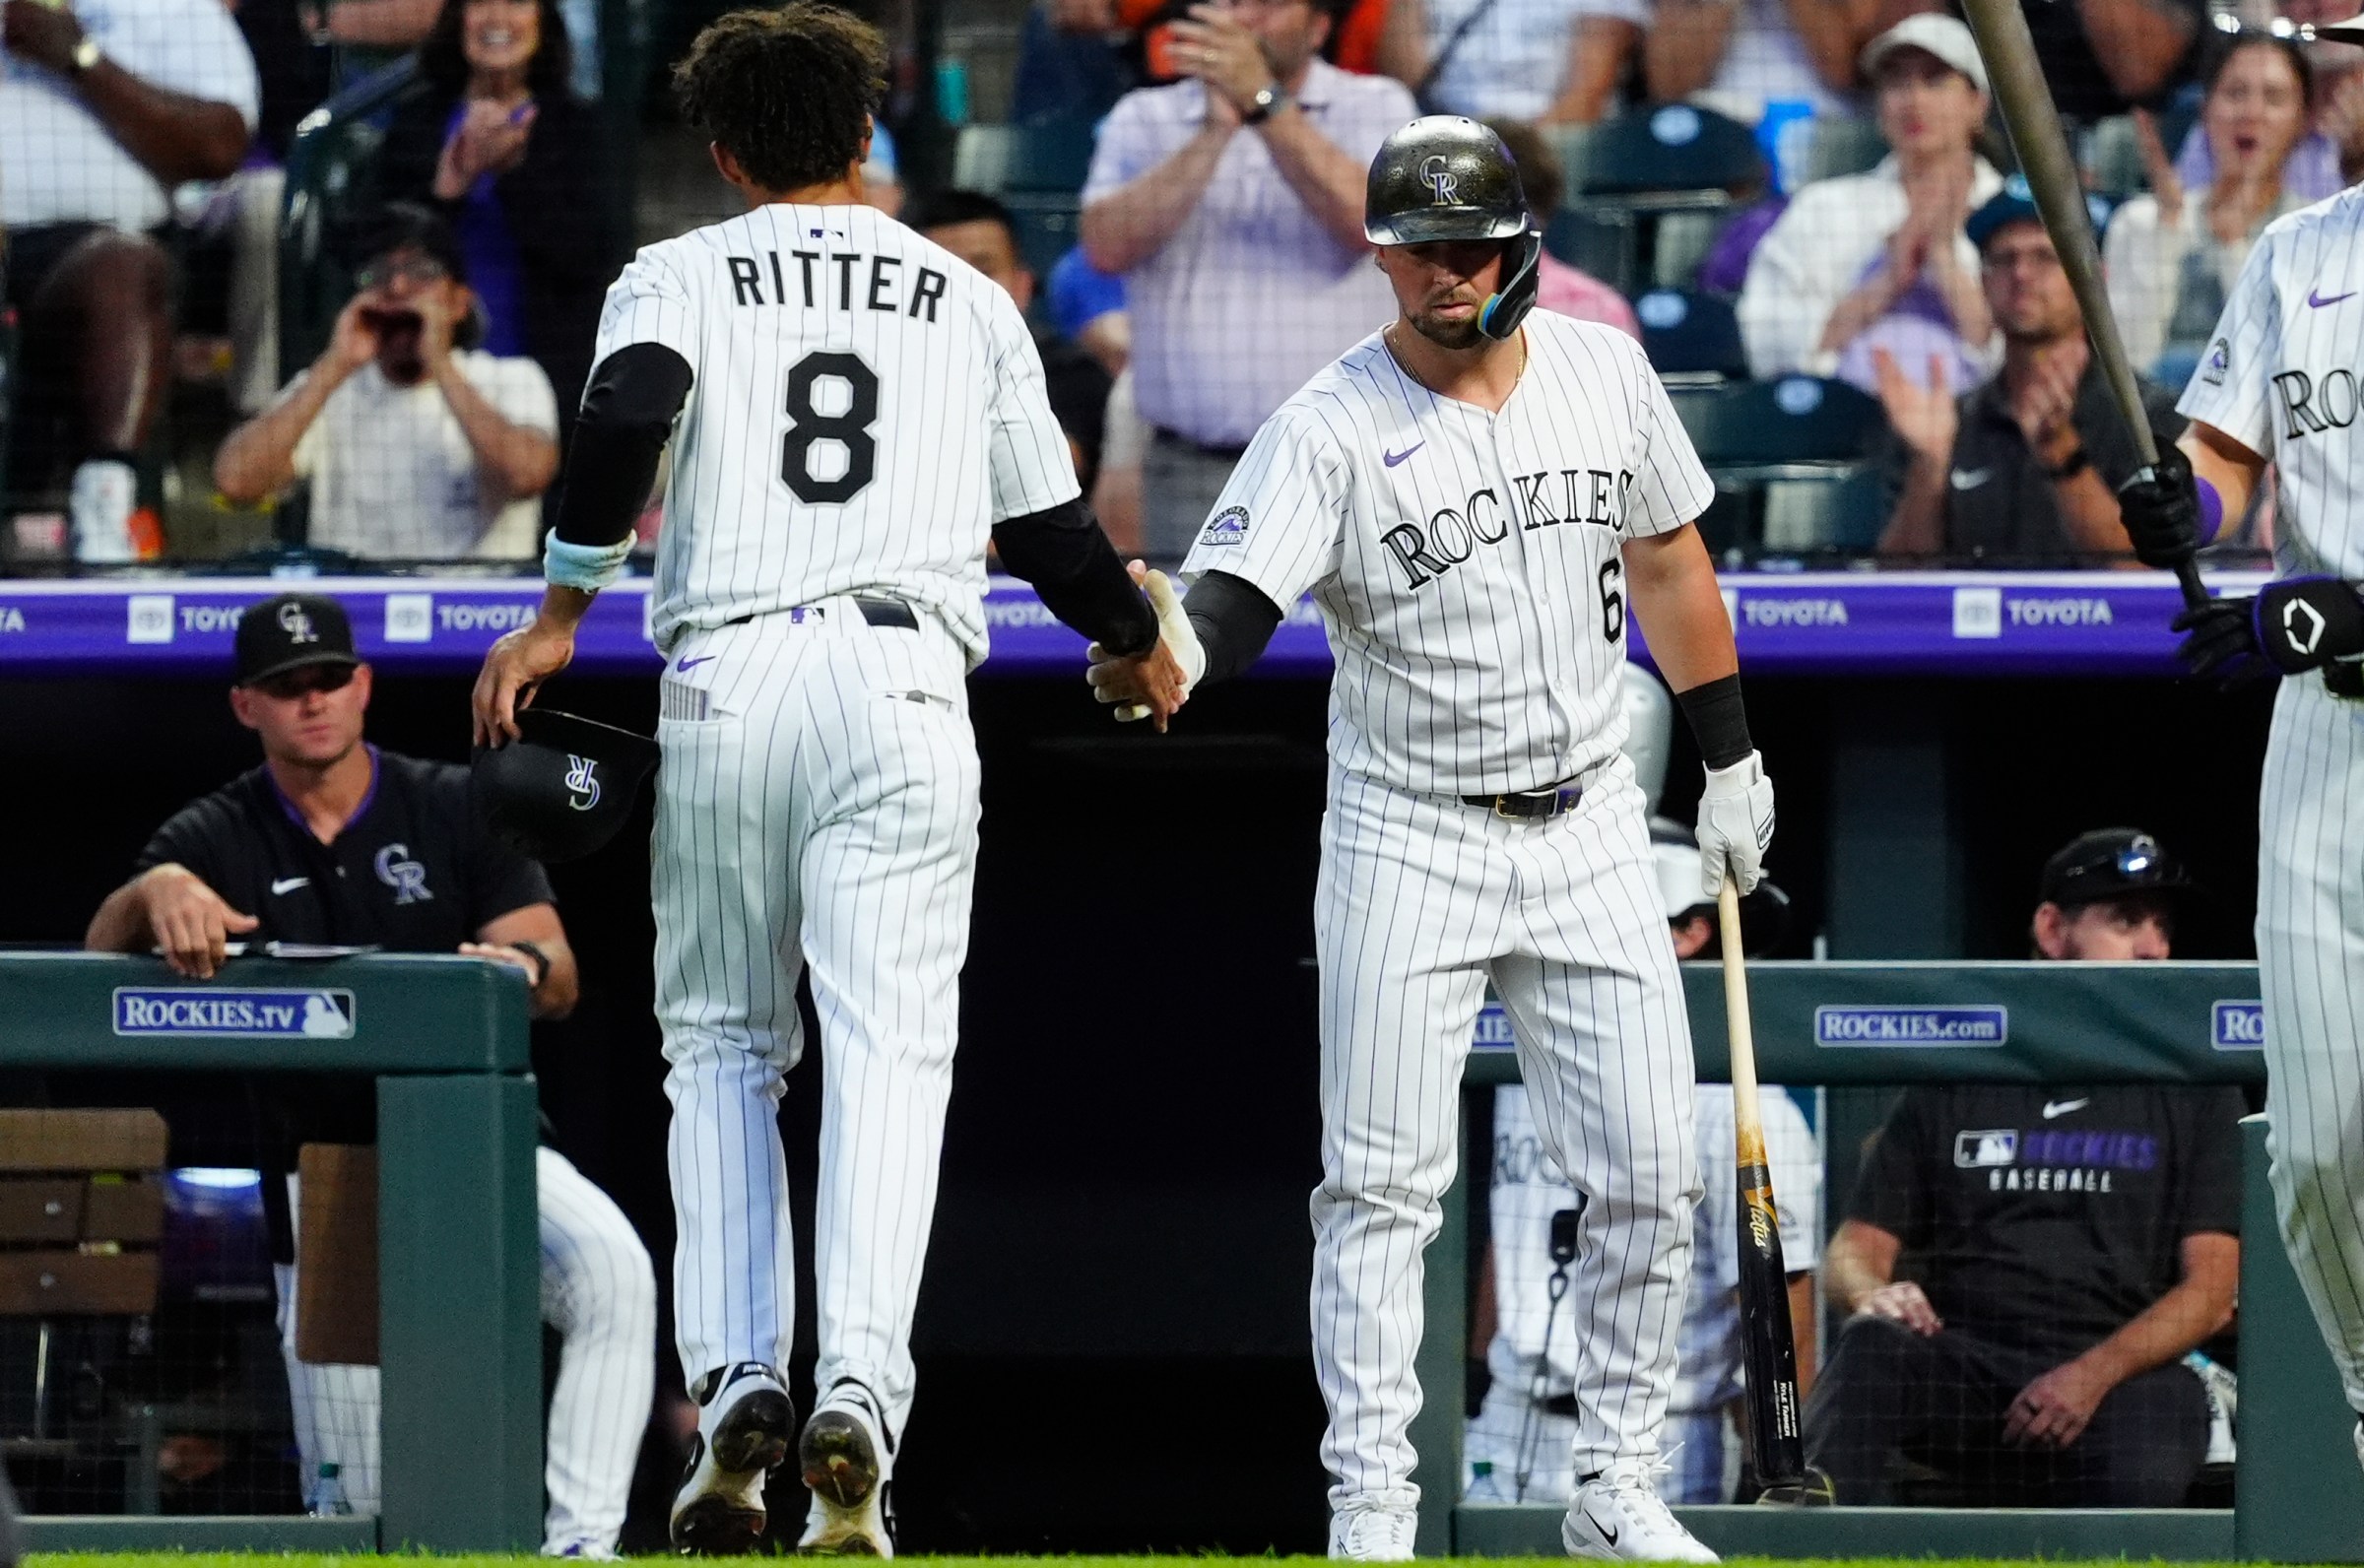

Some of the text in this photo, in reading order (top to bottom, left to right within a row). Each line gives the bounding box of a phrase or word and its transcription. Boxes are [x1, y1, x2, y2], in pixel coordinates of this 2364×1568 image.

[727, 249, 948, 323] RITTER
[777, 349, 882, 507] 8
[2272, 369, 2364, 439] RO
[1380, 469, 1634, 591] ROCKIES
[1598, 556, 1623, 645] 6
[1741, 599, 1849, 626] TOYOTA
[2005, 598, 2113, 625] TOYOTA
[1824, 1013, 1997, 1039] ROCKIES.com
